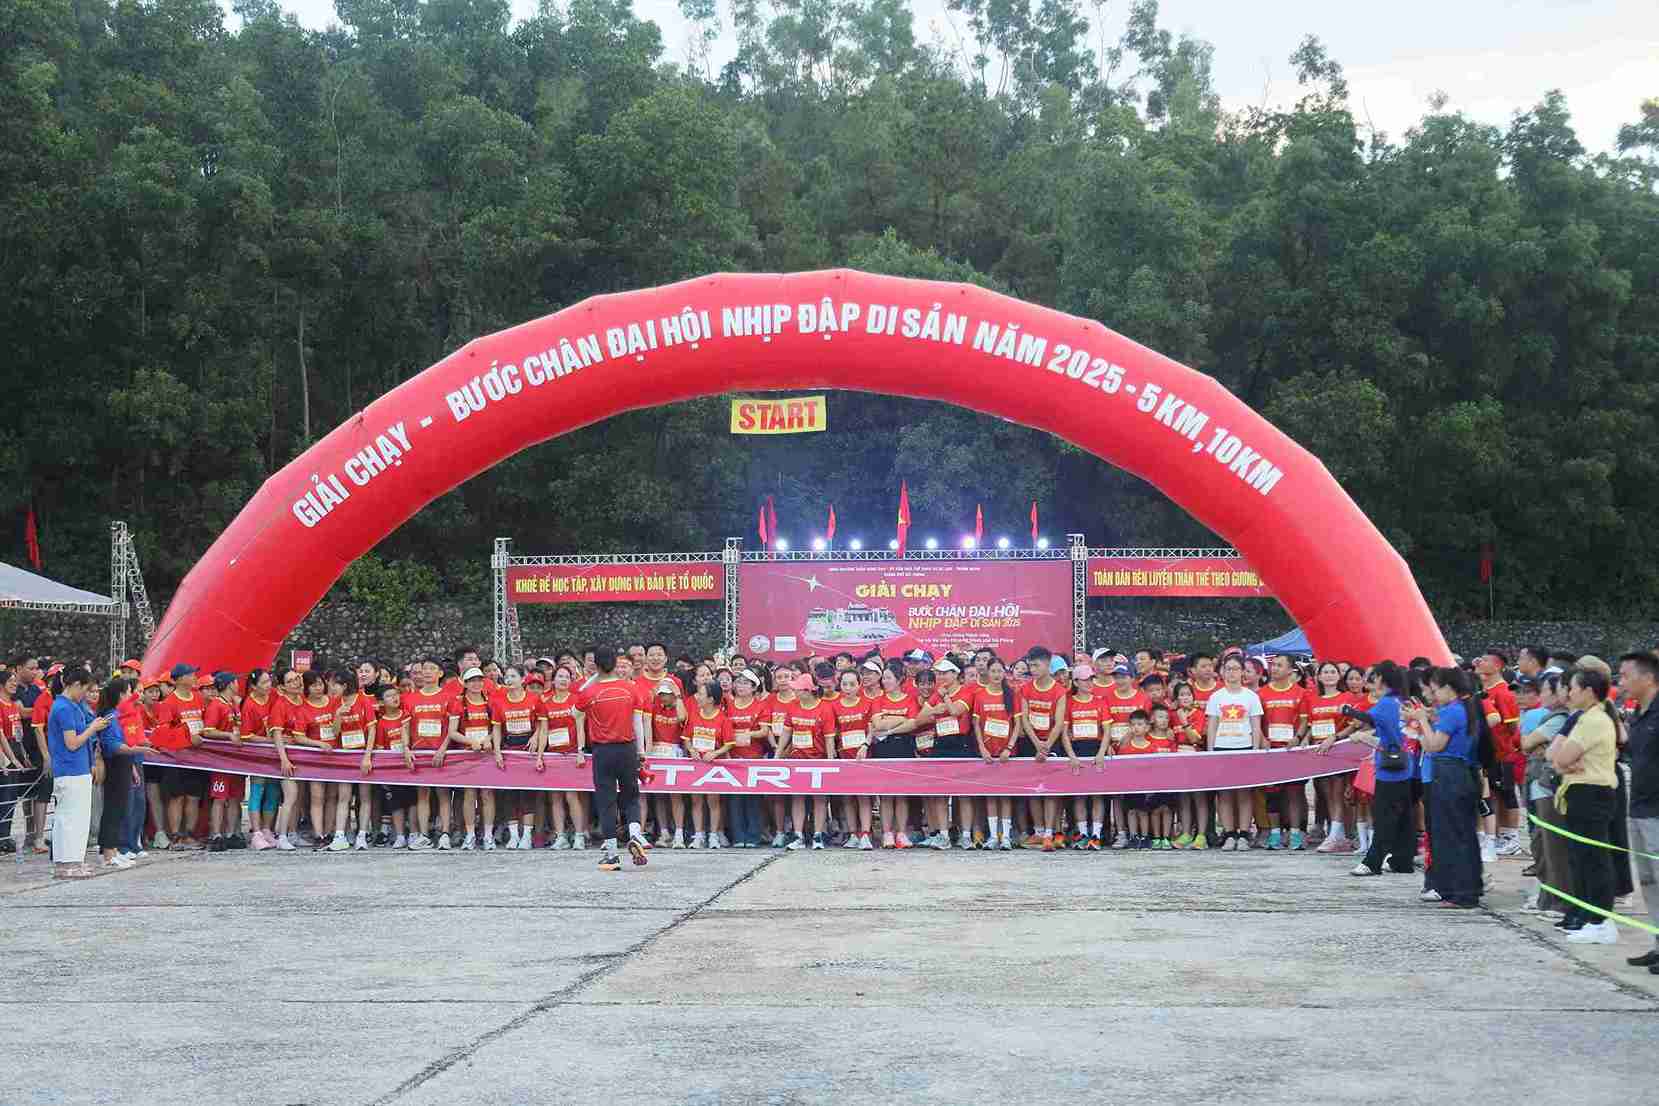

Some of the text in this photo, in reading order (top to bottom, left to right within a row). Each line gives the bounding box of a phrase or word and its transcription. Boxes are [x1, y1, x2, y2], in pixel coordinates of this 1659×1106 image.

[291, 471, 350, 528] GIẢI
[344, 421, 413, 486] CHẠY
[446, 360, 522, 422] BƯỚC
[523, 334, 604, 387] CHÂN
[606, 320, 659, 361] ĐẠI
[661, 305, 712, 350] HỘI
[720, 303, 792, 342] NHỊP
[797, 296, 861, 341] ĐẬP
[865, 303, 899, 336] DI
[901, 303, 968, 345] SẢN
[972, 320, 1048, 368] NĂM
[1046, 344, 1128, 395] 2025
[738, 401, 817, 431] START
[855, 580, 953, 600] GIẢI CHẠY
[649, 764, 840, 789] TART
